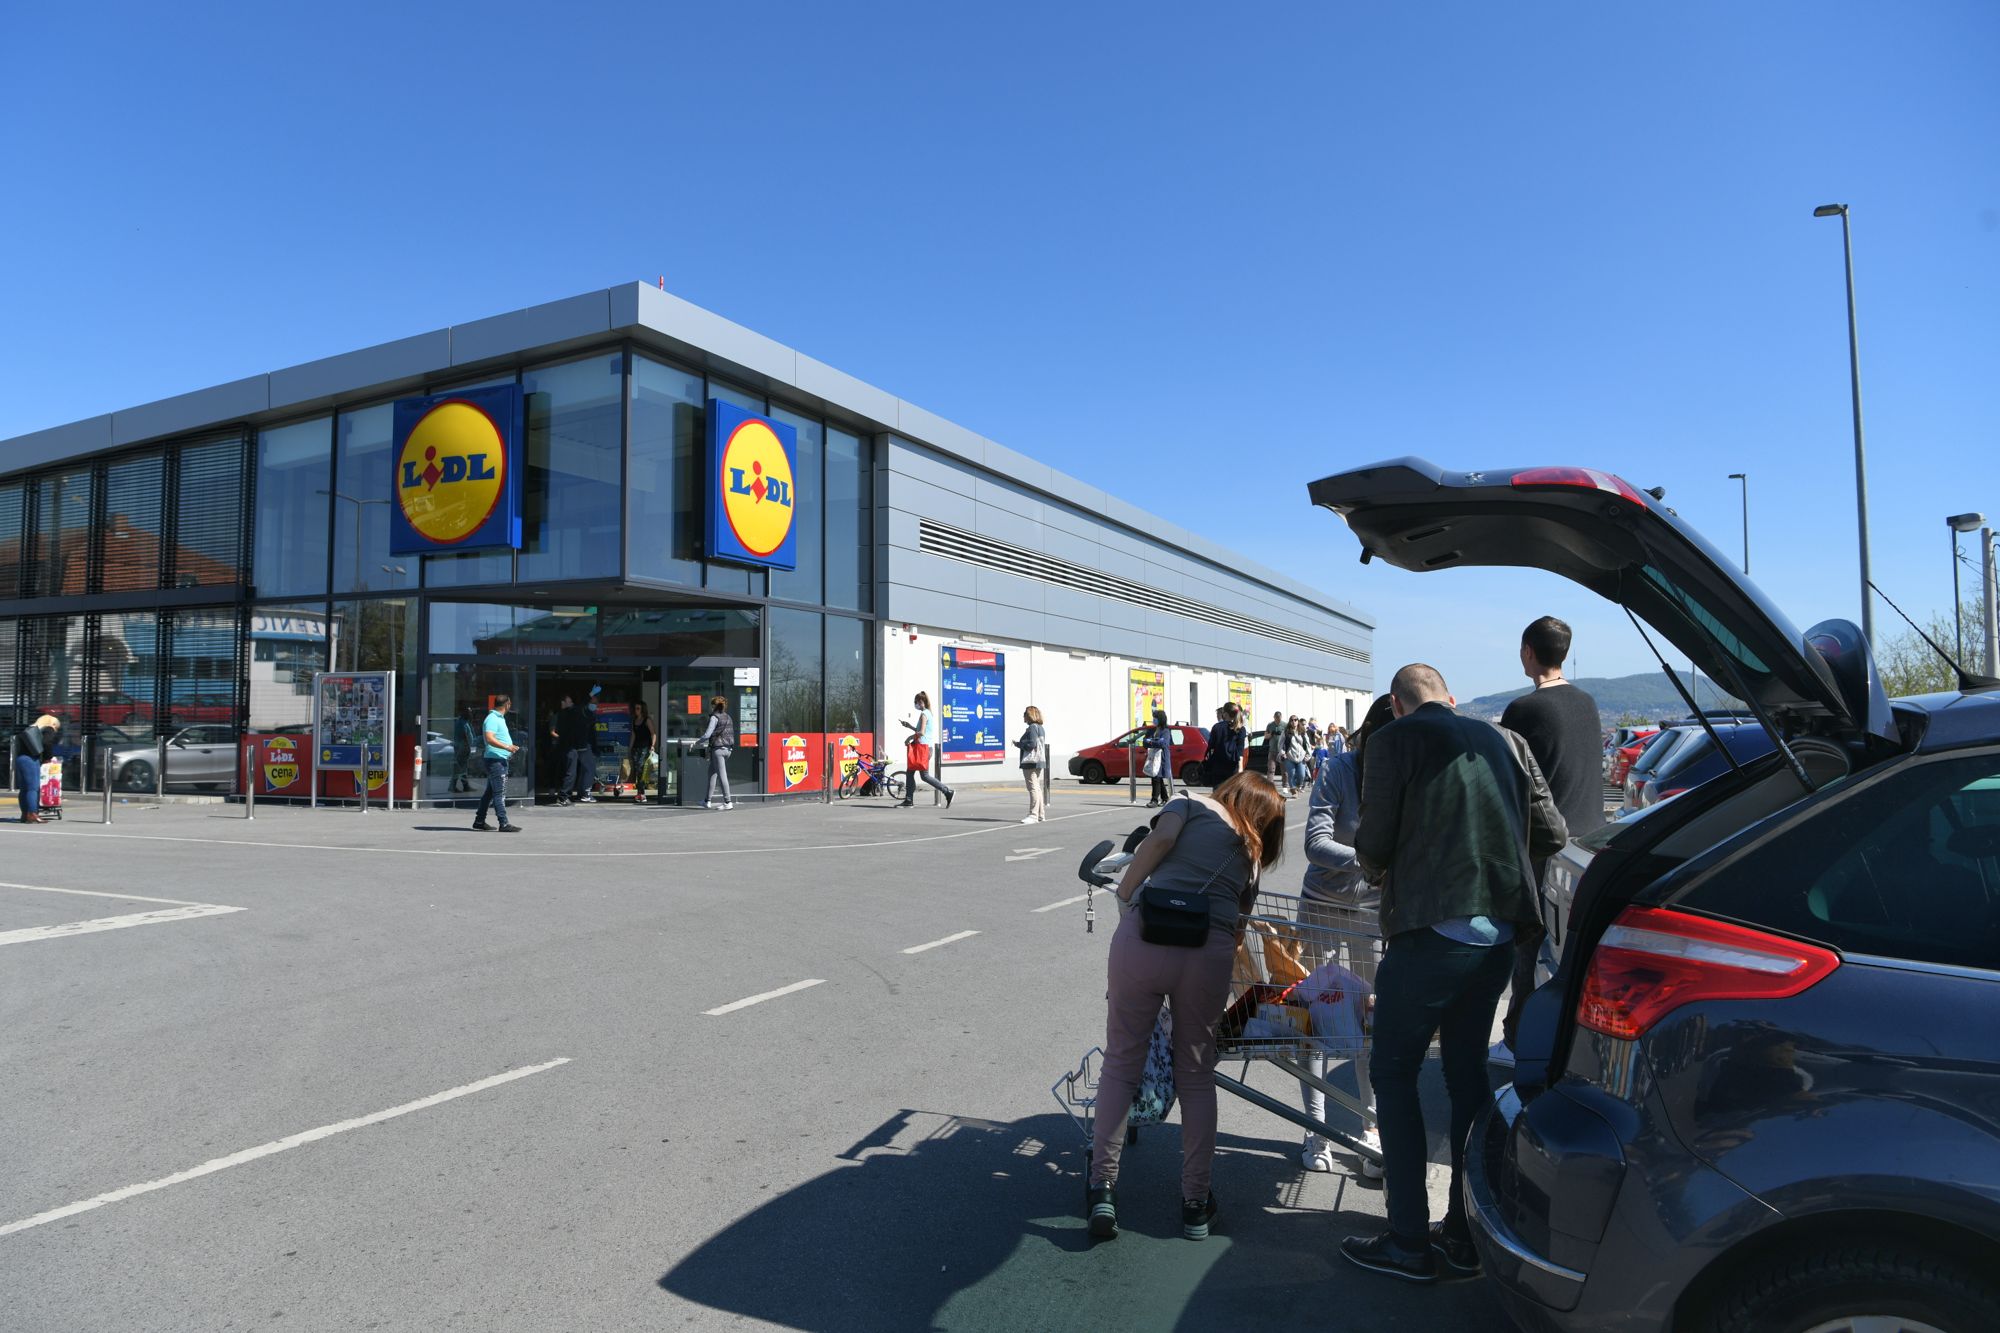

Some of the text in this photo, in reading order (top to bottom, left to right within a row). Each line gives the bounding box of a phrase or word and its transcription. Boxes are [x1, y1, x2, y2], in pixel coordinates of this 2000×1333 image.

[271, 768, 293, 779] cena
[368, 770, 384, 780] ena
[788, 765, 804, 776] cena
